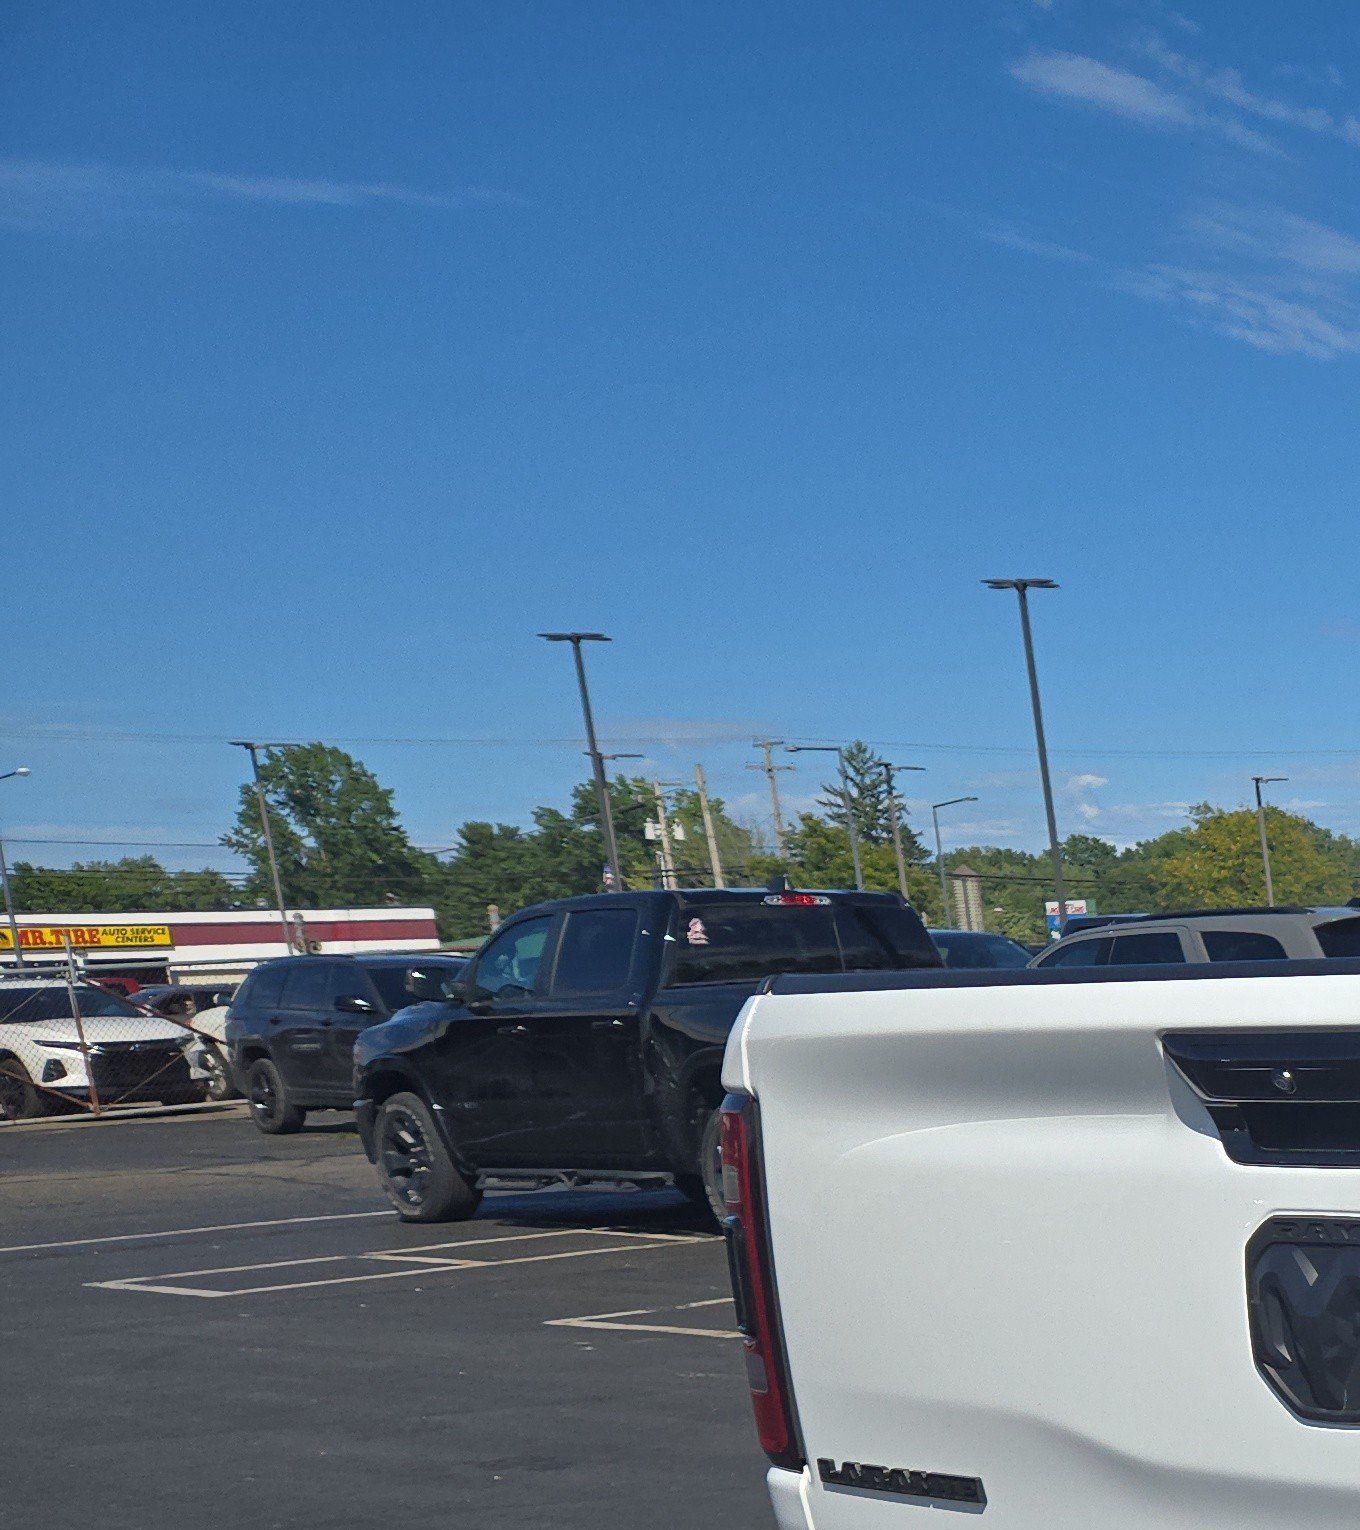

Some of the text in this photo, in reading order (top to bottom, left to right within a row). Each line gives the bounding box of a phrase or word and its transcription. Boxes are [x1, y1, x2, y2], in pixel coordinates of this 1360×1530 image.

[101, 926, 166, 936] AUTO SERVICE
[115, 935, 155, 943] CENTERS
